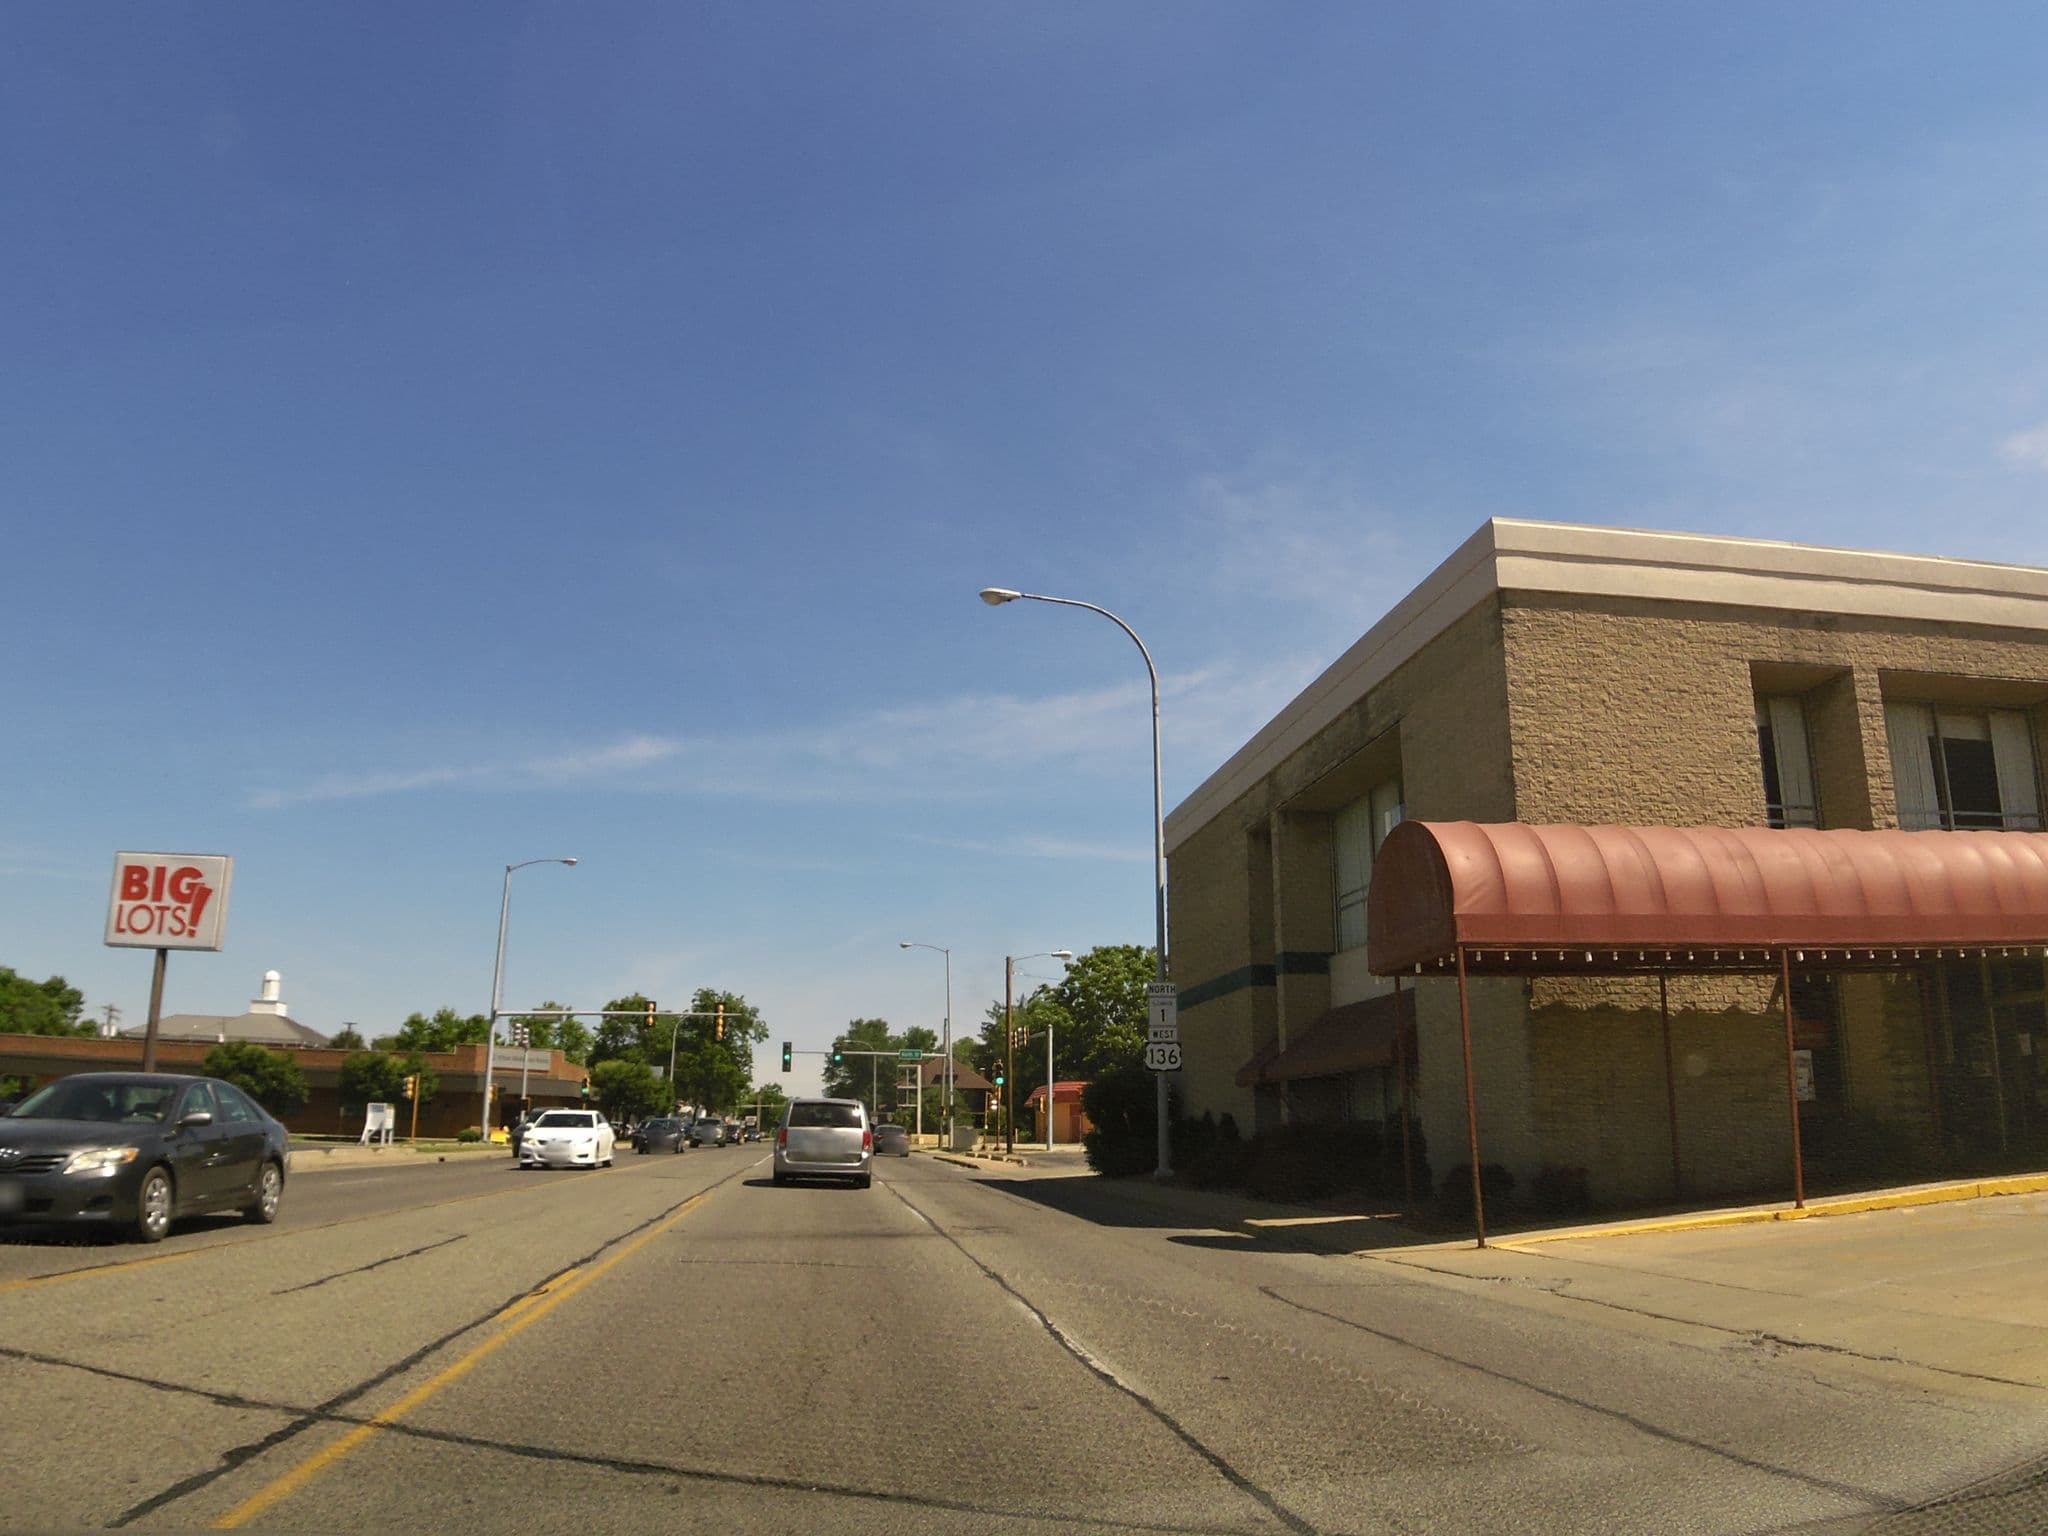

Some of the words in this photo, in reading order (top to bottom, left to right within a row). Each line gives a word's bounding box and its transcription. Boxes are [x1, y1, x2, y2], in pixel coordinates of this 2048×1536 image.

[121, 865, 205, 904] BIG
[115, 886, 213, 937] LOTS!
[1149, 984, 1176, 994] NORTH
[1160, 1008, 1166, 1023] 1
[1152, 1030, 1174, 1040] WEST
[1149, 1047, 1178, 1065] 136
